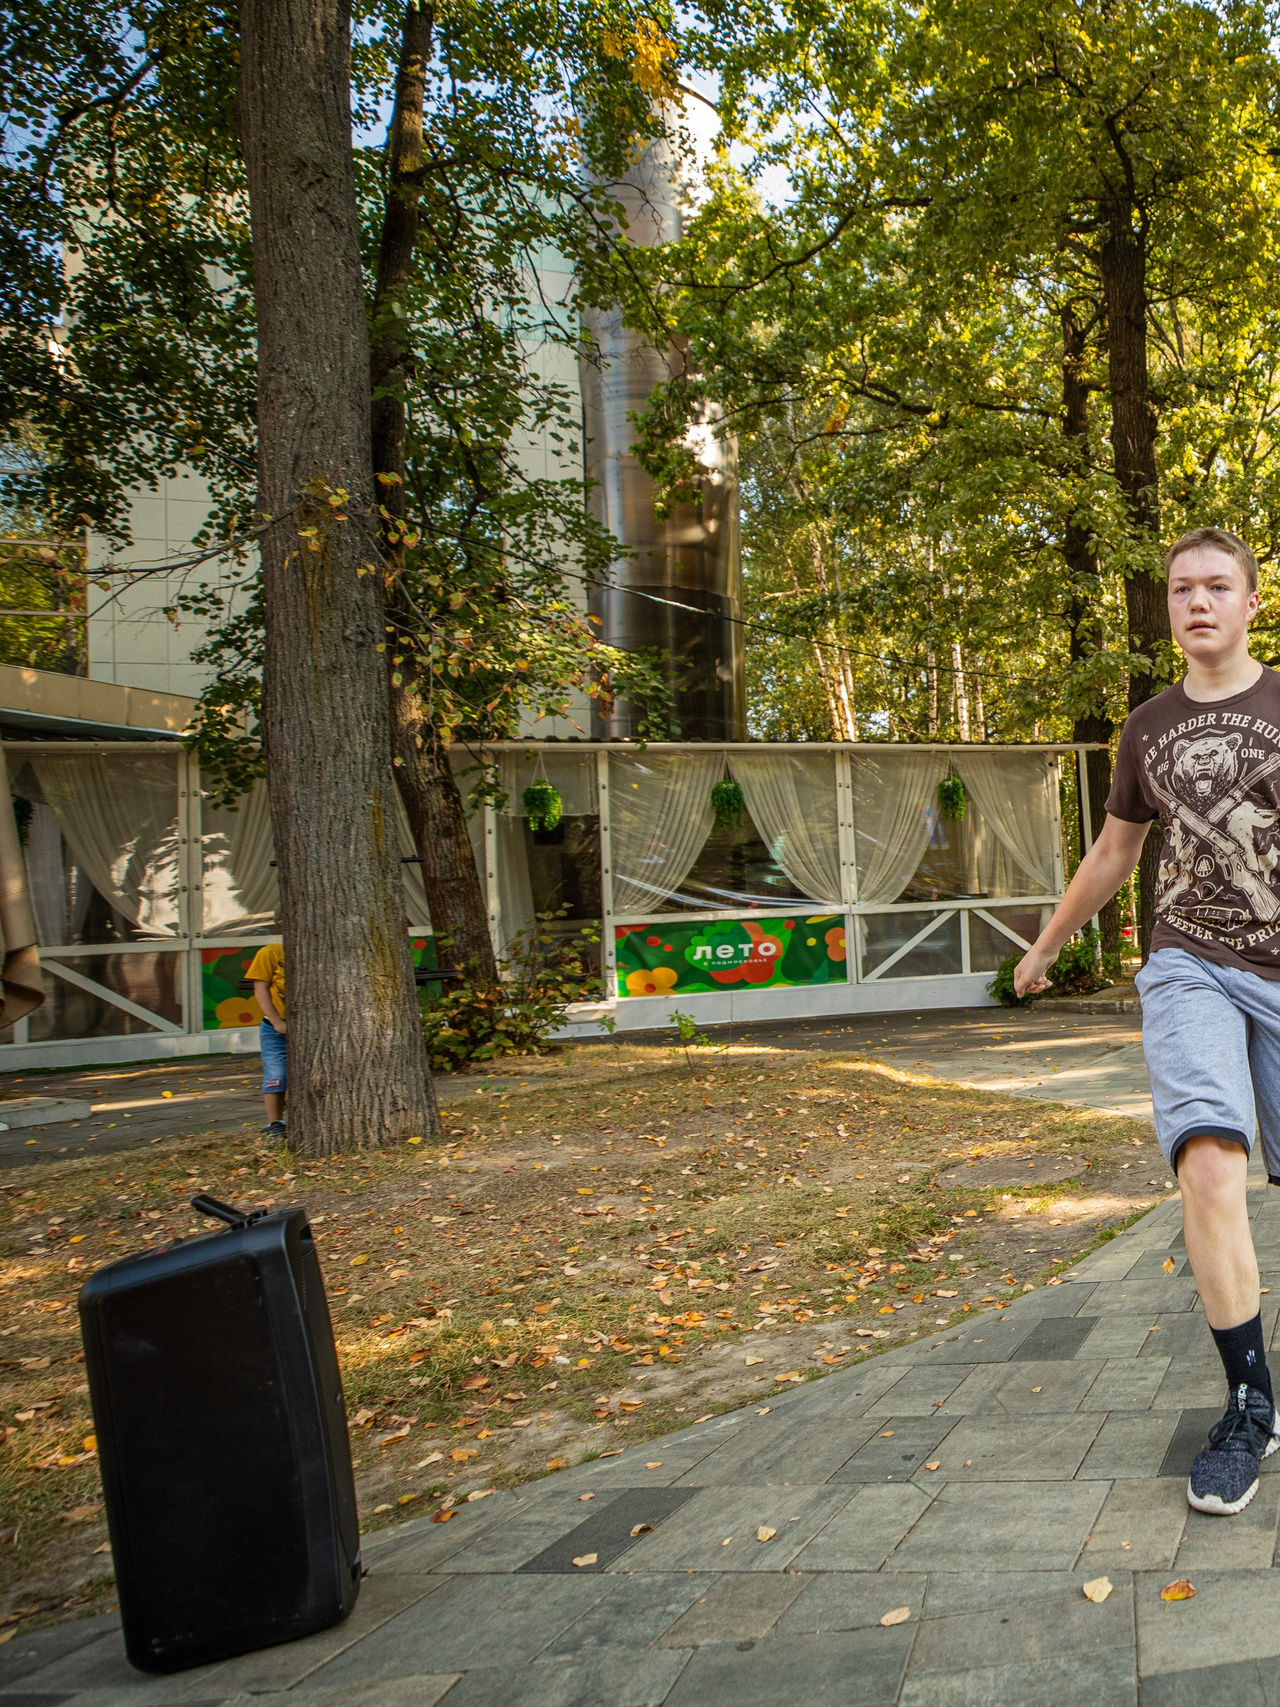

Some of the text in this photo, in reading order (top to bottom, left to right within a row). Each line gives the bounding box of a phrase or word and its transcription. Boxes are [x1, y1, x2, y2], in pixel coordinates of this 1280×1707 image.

[1157, 712, 1217, 750] HARDER
[1220, 712, 1252, 728] THE
[1240, 748, 1265, 760] ONE
[693, 942, 777, 960] лето
